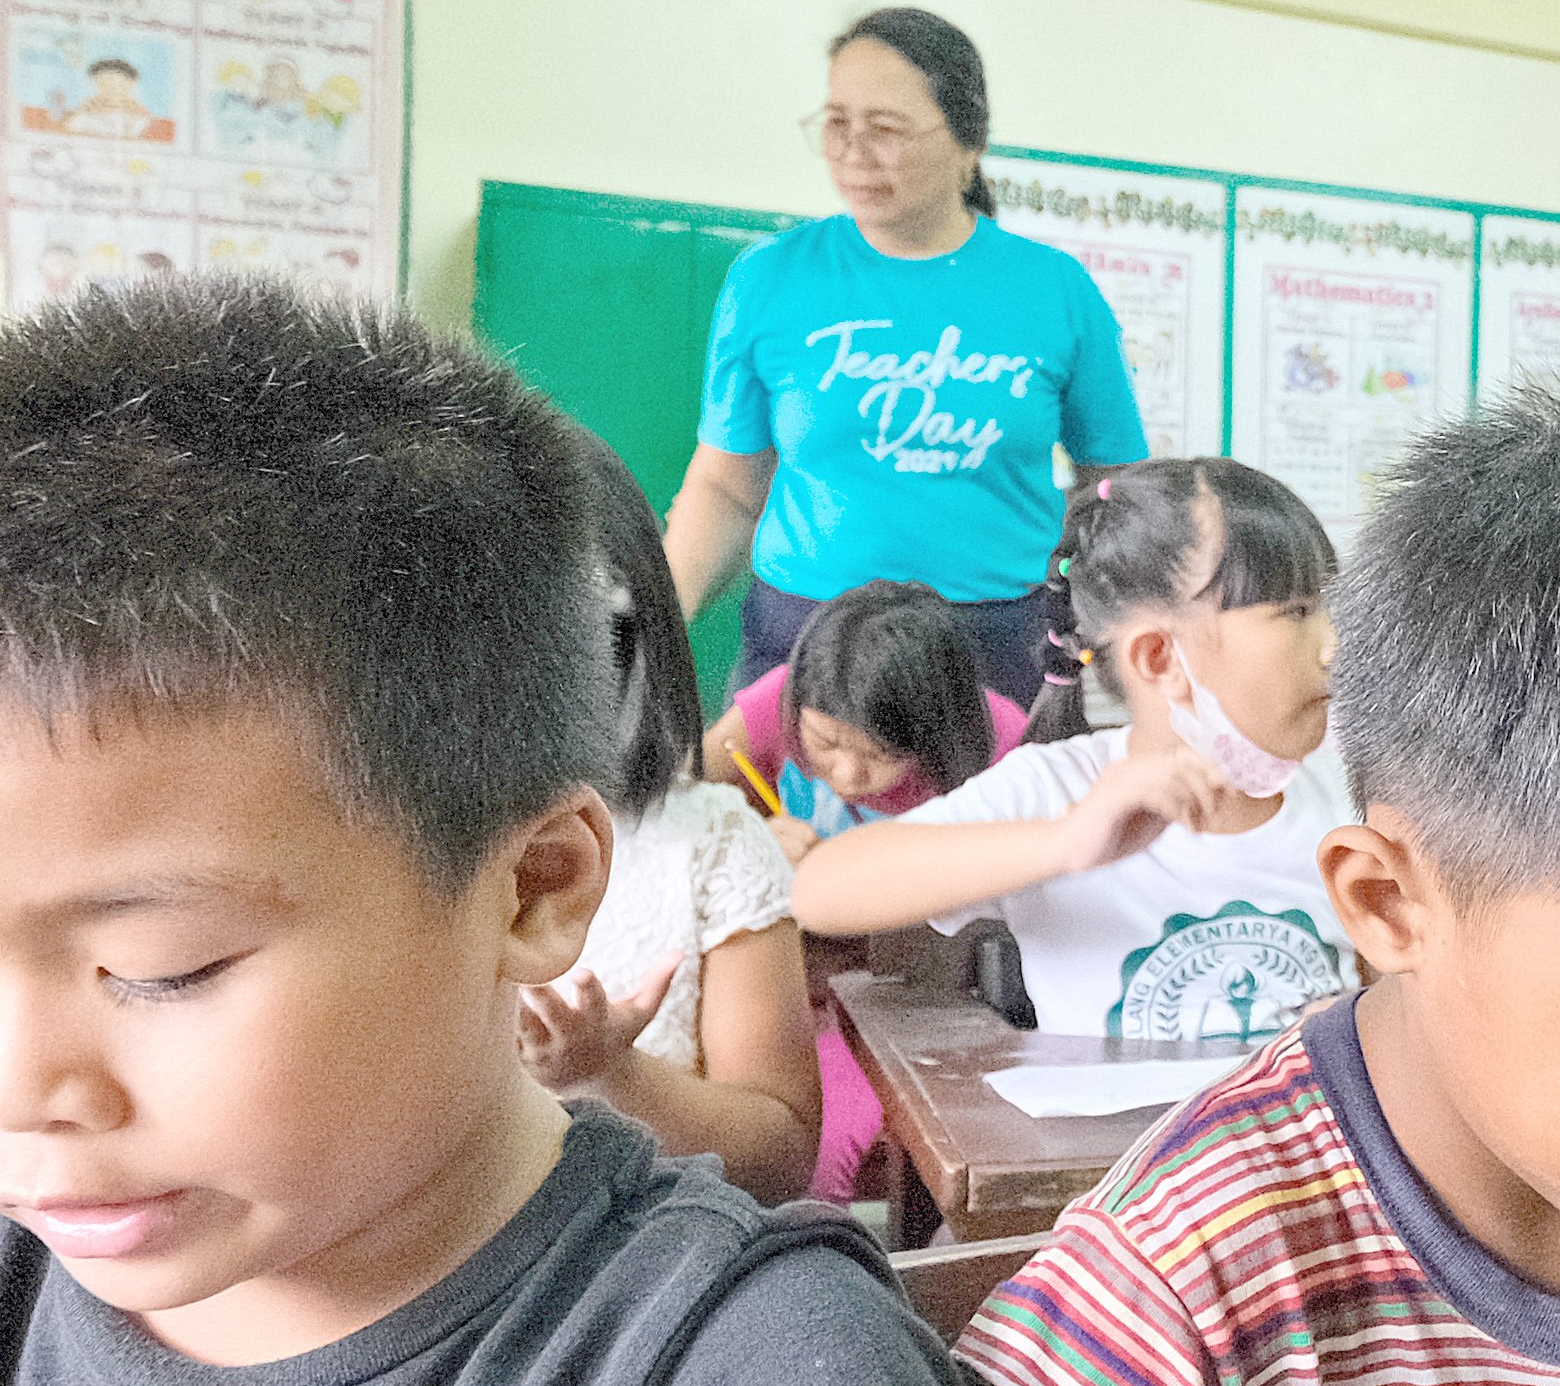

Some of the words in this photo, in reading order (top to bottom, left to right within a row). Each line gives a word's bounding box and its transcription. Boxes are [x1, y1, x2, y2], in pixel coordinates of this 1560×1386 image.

[858, 379, 1003, 470] Day
[1125, 982, 1151, 1035] LANG
[1147, 921, 1291, 977] ELEMENTARYA
